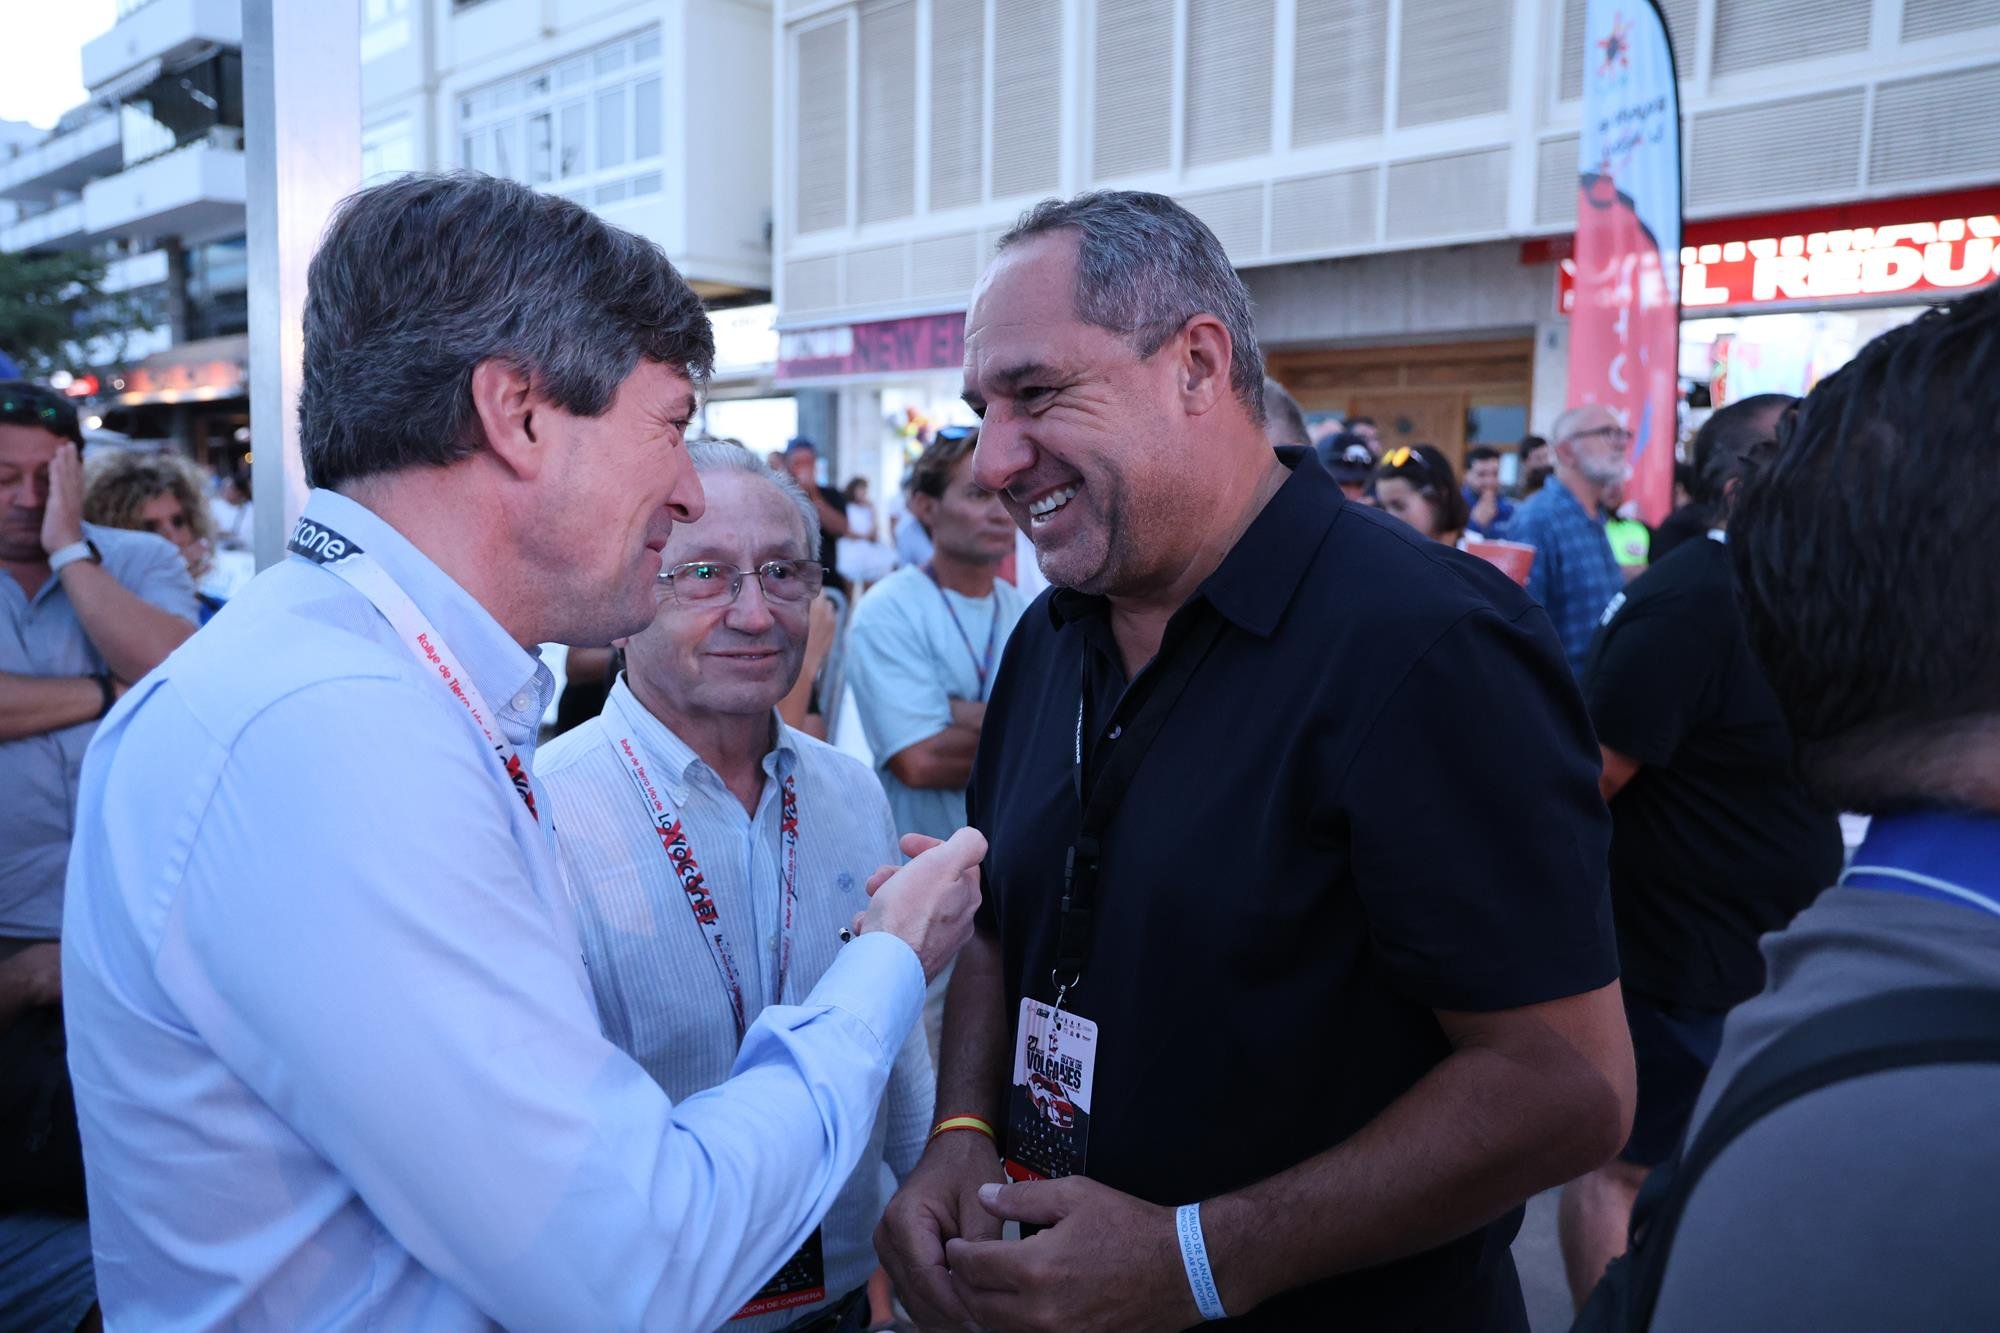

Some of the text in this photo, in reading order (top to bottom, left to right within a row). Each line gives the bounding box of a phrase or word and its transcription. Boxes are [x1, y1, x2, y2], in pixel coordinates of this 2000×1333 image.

[1753, 238, 2000, 301] REDU
[853, 319, 917, 372] NEW
[416, 632, 441, 664] Rallye
[438, 663, 451, 679] de
[1027, 1050, 1082, 1090] VOLCANES
[1189, 1207, 1218, 1306] CABILDO DE LANZAROTE
[1190, 1266, 1199, 1278] DE
